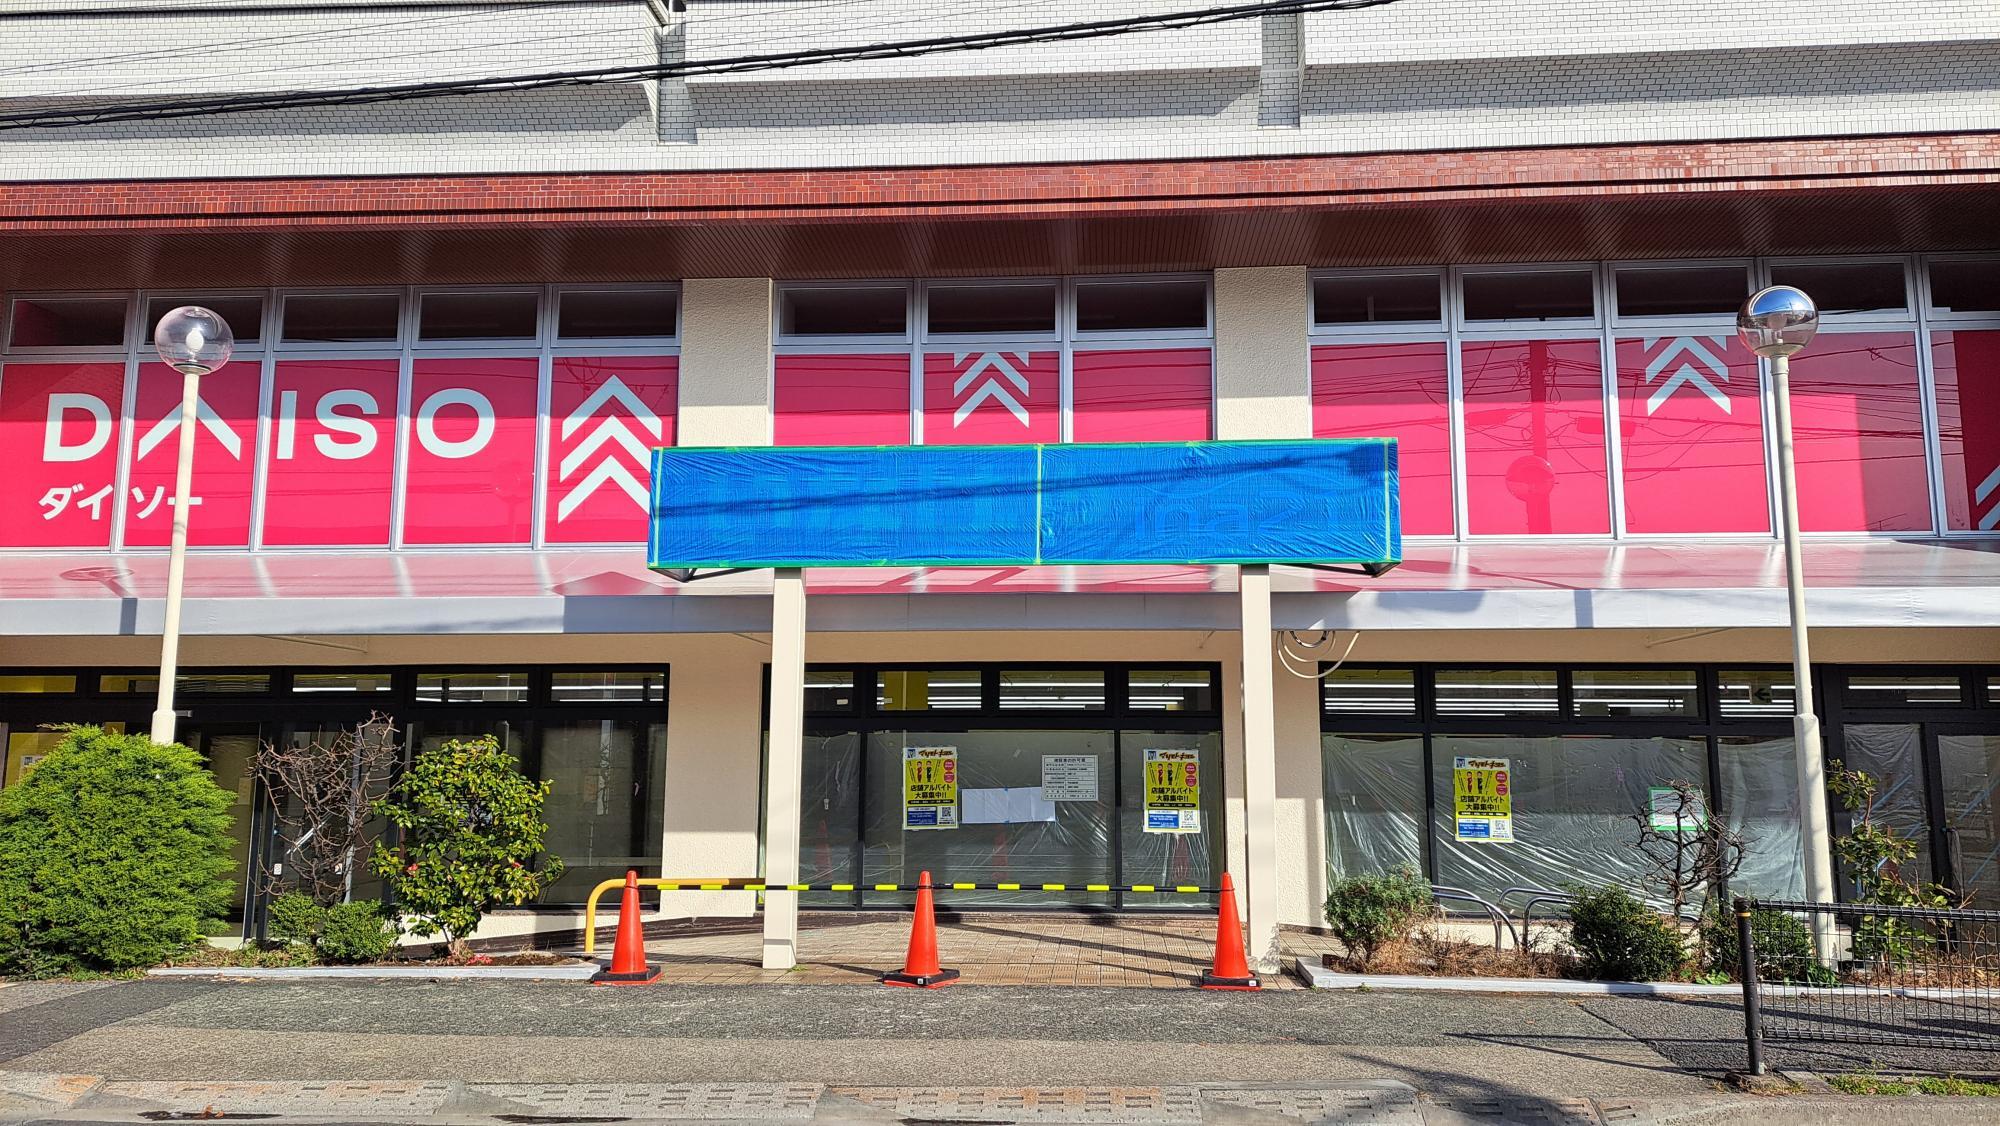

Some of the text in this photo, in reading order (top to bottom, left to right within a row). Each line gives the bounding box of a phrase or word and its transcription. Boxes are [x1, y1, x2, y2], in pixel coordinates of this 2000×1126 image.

[43, 388, 495, 462] DAISO
[38, 483, 203, 521] ダイソー
